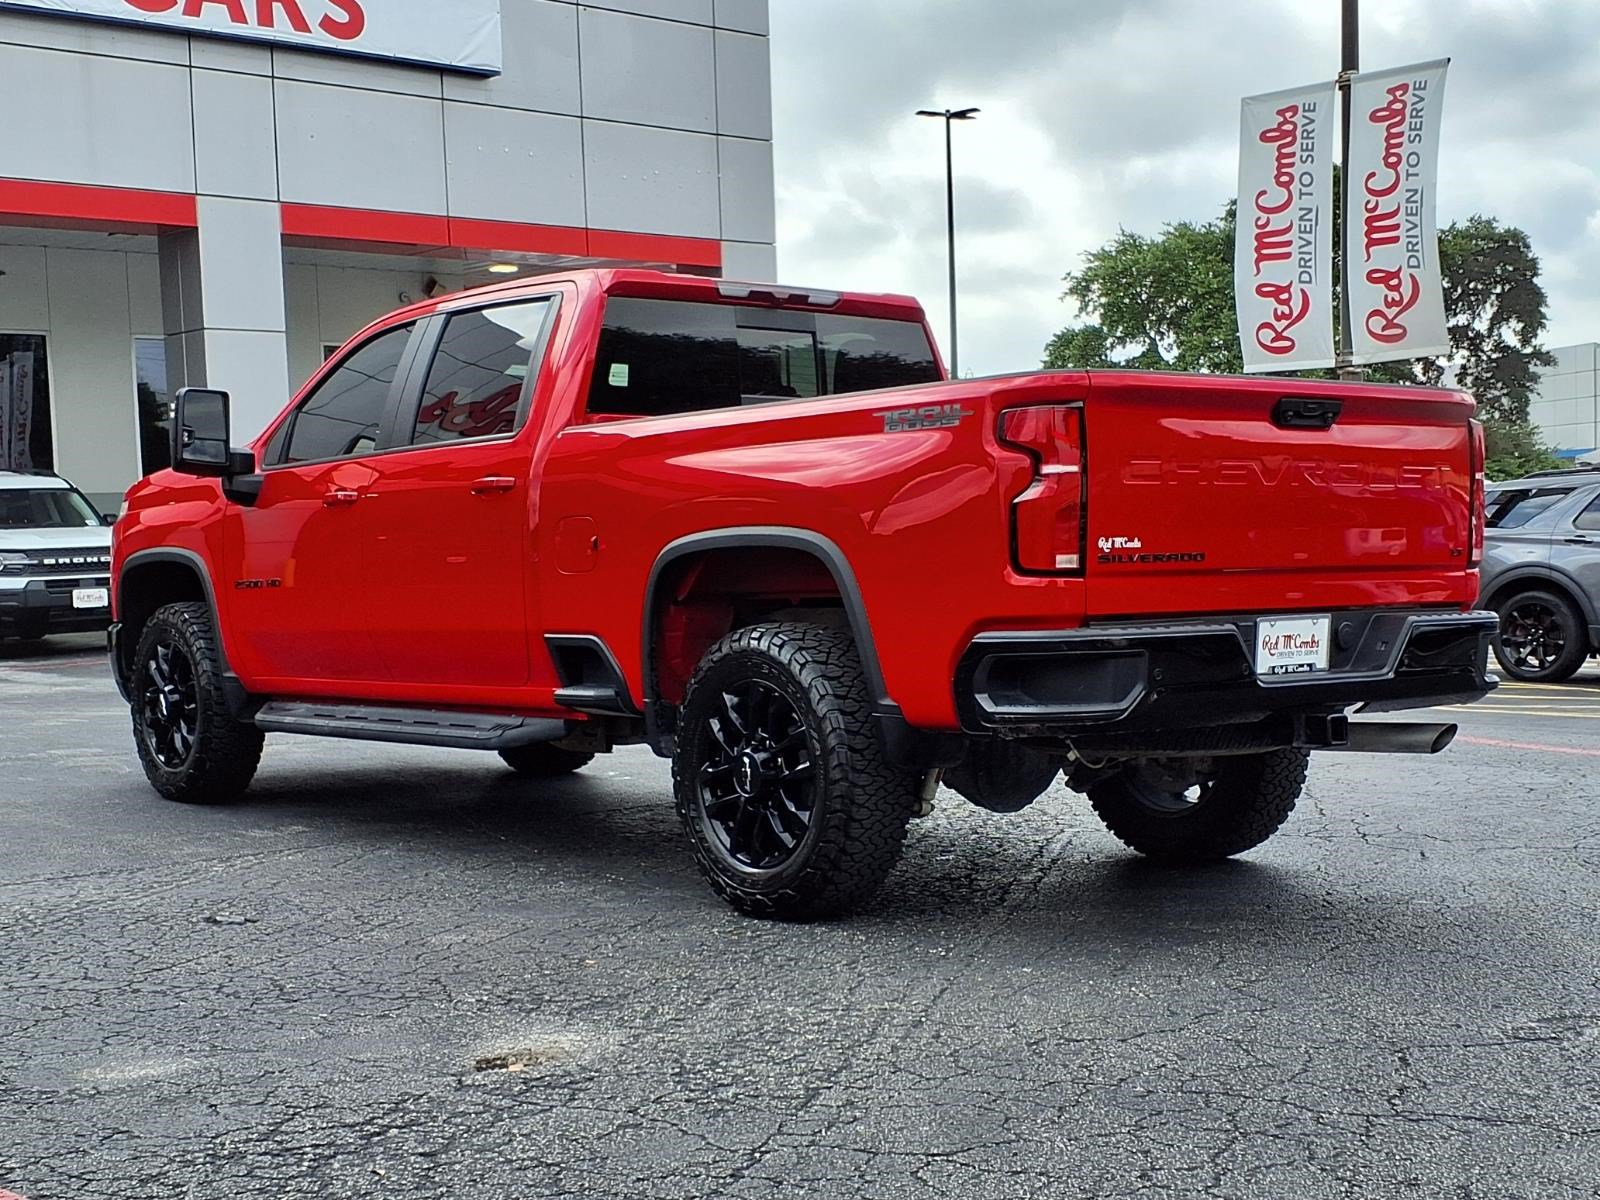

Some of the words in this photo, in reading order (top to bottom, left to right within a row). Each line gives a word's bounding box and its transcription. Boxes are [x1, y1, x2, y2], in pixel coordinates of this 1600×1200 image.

[1301, 101, 1317, 164] SERVE
[1409, 79, 1428, 144] SERVE
[1254, 104, 1299, 277] McCombs
[1299, 171, 1314, 200] TO
[1364, 82, 1410, 263] McCombs
[1405, 151, 1421, 181] TO
[1298, 207, 1313, 285] DRIVEN
[1405, 188, 1421, 270] DRIVEN
[1256, 280, 1310, 355] Red
[1366, 268, 1420, 344] Red
[1098, 537, 1112, 552] Red
[1098, 552, 1205, 564] SILVERADO
[1262, 634, 1280, 656] Red
[1281, 633, 1320, 649] McCombs
[1274, 665, 1286, 674] Red
[1276, 650, 1295, 658] DRIVEN
